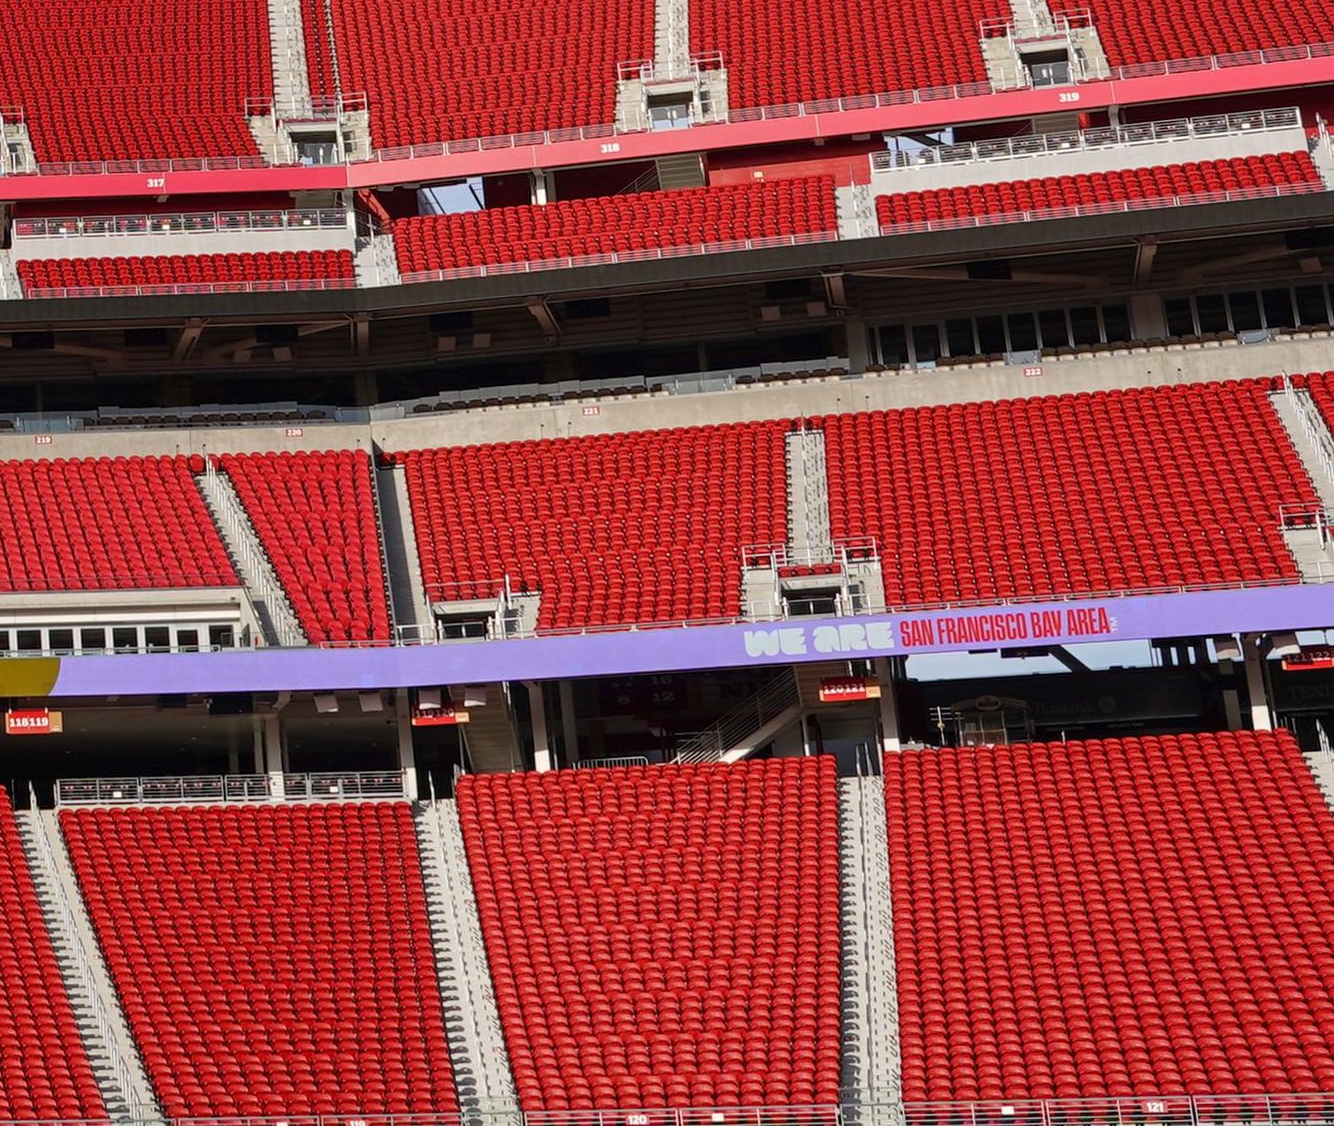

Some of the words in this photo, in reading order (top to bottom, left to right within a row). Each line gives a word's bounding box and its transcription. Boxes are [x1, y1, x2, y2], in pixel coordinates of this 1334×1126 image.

[1059, 92, 1079, 102] 319
[601, 143, 620, 153] 318
[147, 178, 165, 188] 317
[743, 628, 807, 657] WE
[899, 619, 934, 647] SAN
[936, 613, 1028, 645] FRANCISCO
[1030, 610, 1066, 641] BAY
[1067, 608, 1111, 637] AREA
[1146, 1102, 1164, 1112] 121
[627, 1115, 647, 1124] 120
